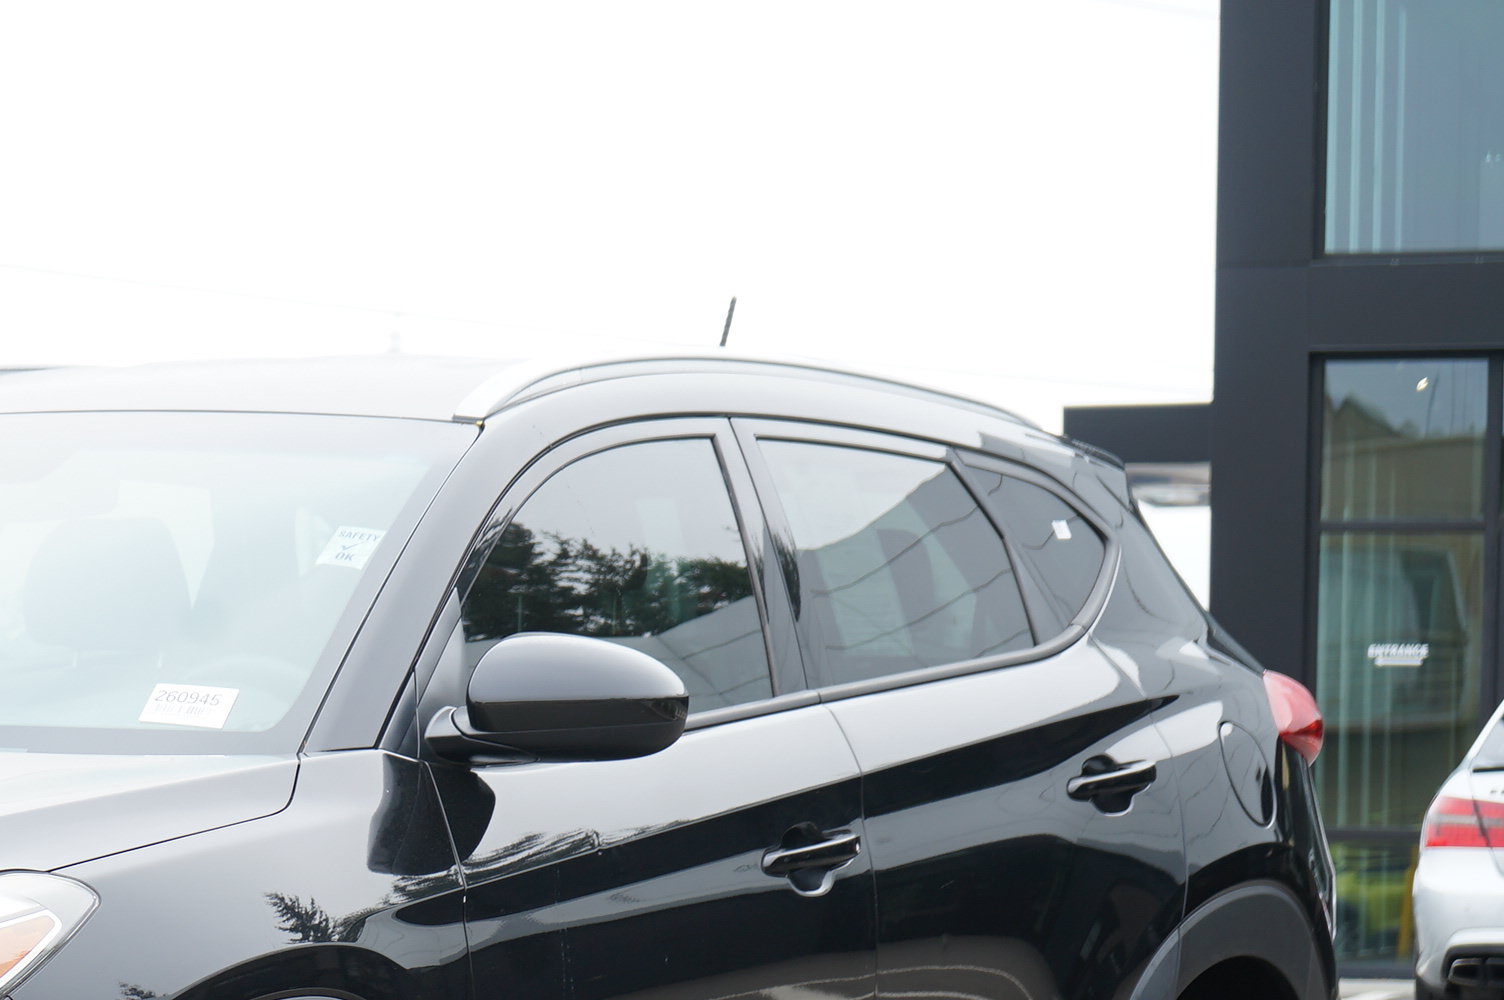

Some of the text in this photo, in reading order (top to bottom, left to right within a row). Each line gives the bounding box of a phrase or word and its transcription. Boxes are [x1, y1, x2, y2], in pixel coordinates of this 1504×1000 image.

[338, 530, 380, 541] SAFETY
[335, 551, 354, 561] OK
[155, 690, 222, 706] 260945
